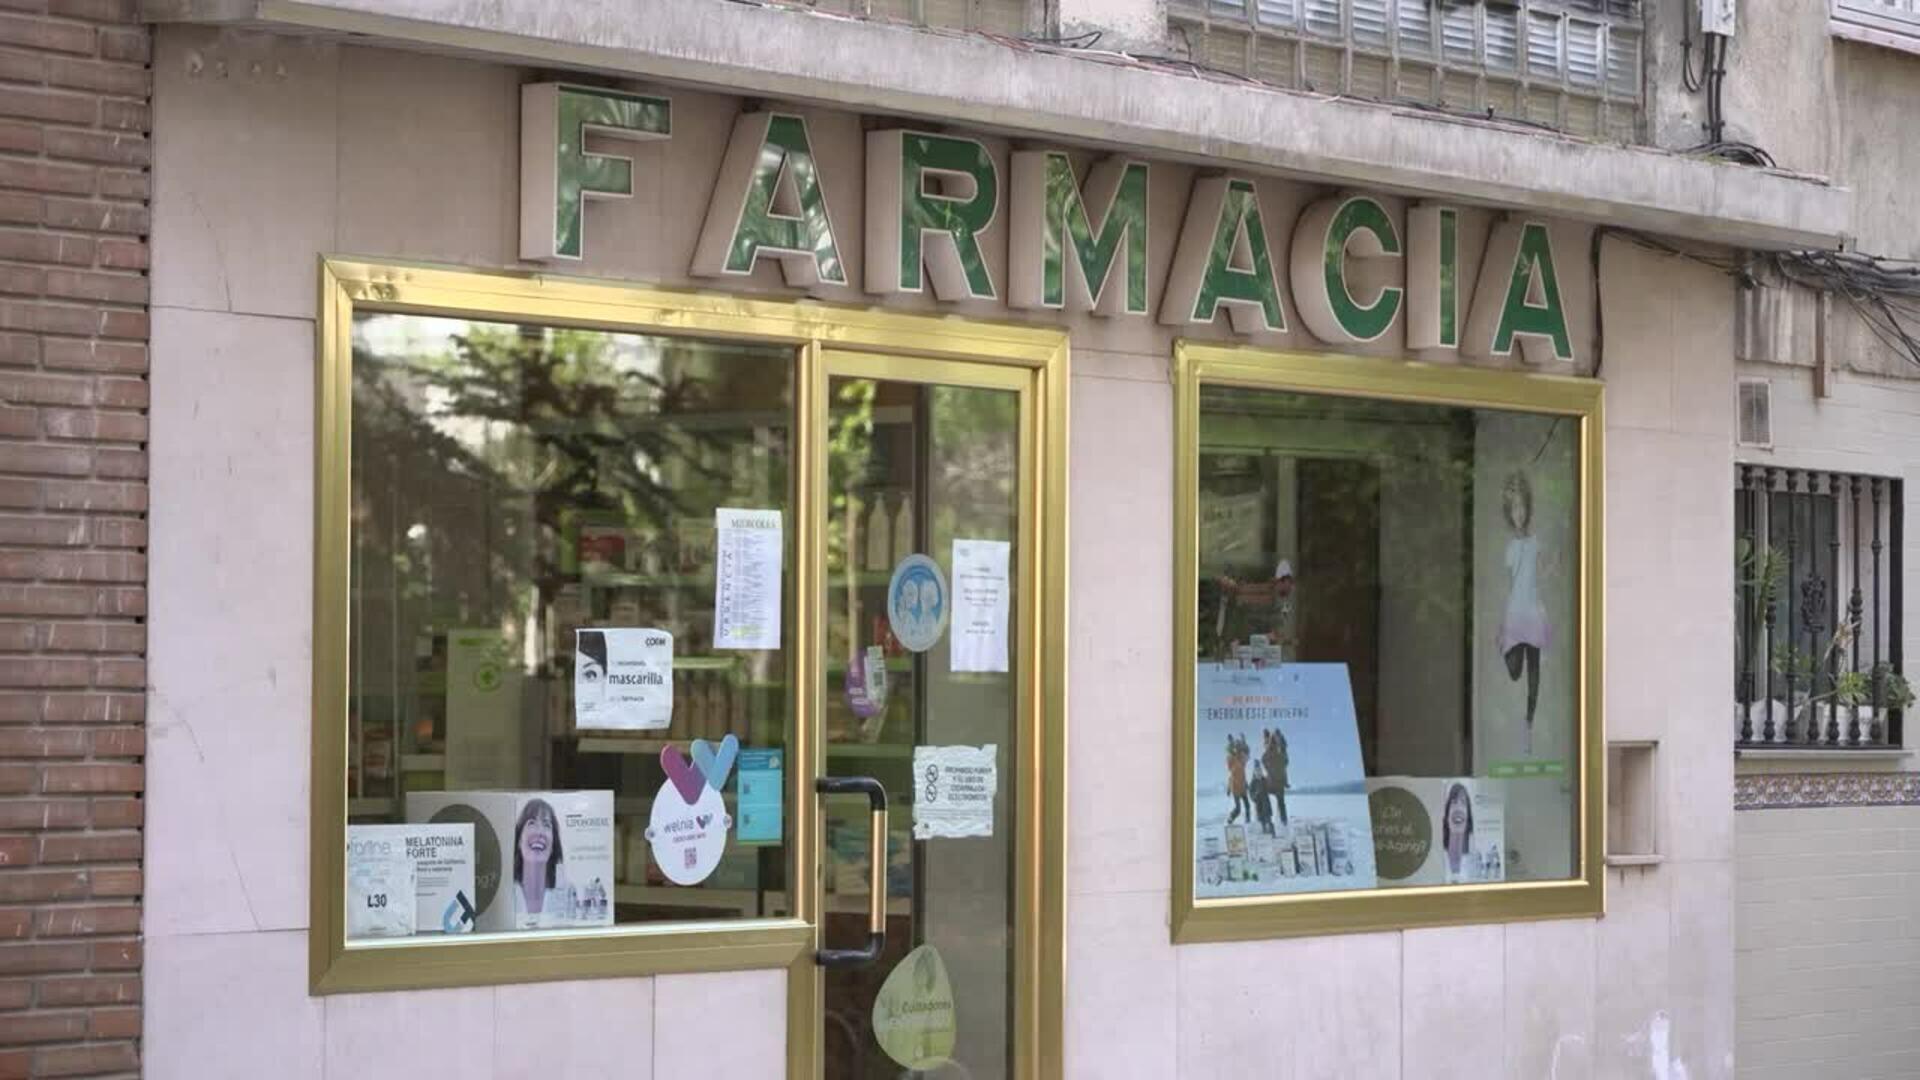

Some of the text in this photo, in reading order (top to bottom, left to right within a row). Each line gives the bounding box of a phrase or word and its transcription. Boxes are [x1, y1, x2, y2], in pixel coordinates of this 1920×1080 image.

[520, 82, 1574, 362] FARMACIA
[608, 671, 664, 686] mascarilla
[405, 836, 464, 848] MELATONINA
[406, 847, 438, 859] FORTE
[367, 893, 388, 908] L30
